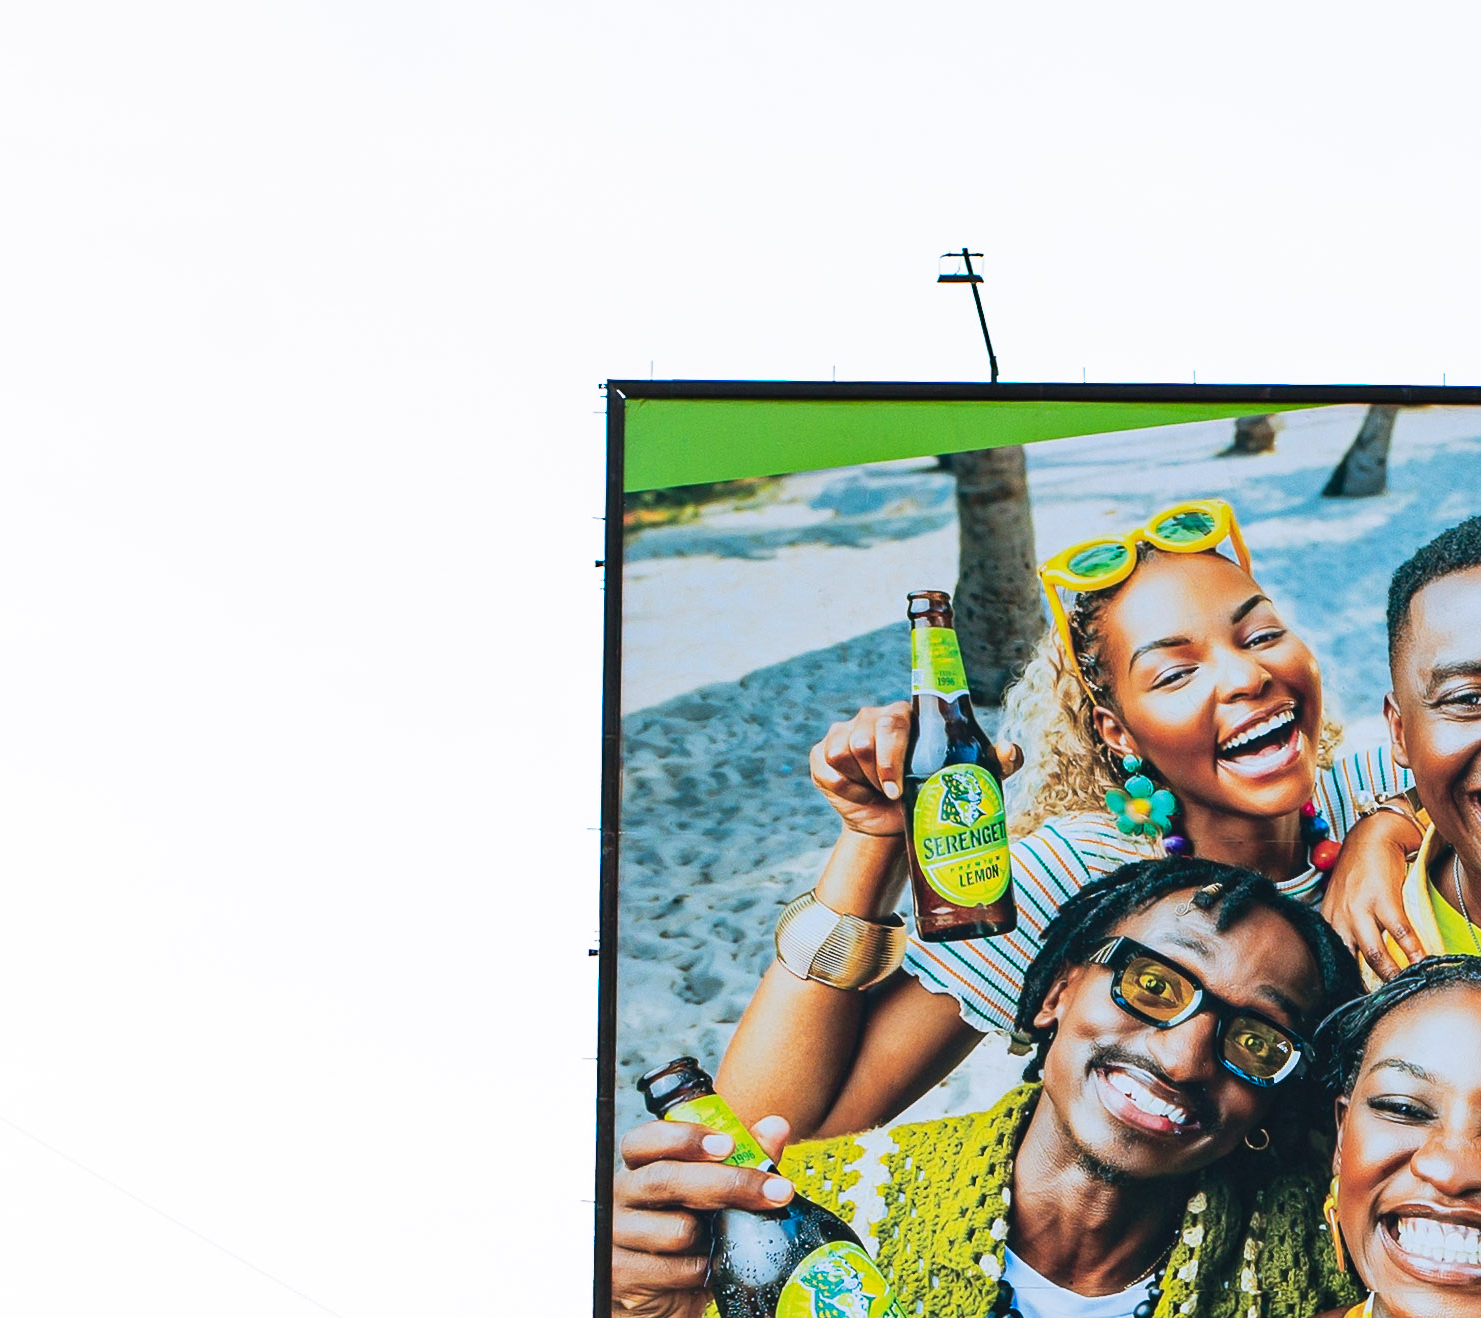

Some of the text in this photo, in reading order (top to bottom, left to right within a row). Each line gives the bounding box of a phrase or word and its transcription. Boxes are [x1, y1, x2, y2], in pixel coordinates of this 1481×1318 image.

[937, 676, 955, 687] 1996
[922, 820, 1008, 861] SERENGET
[958, 862, 1000, 888] LEMON
